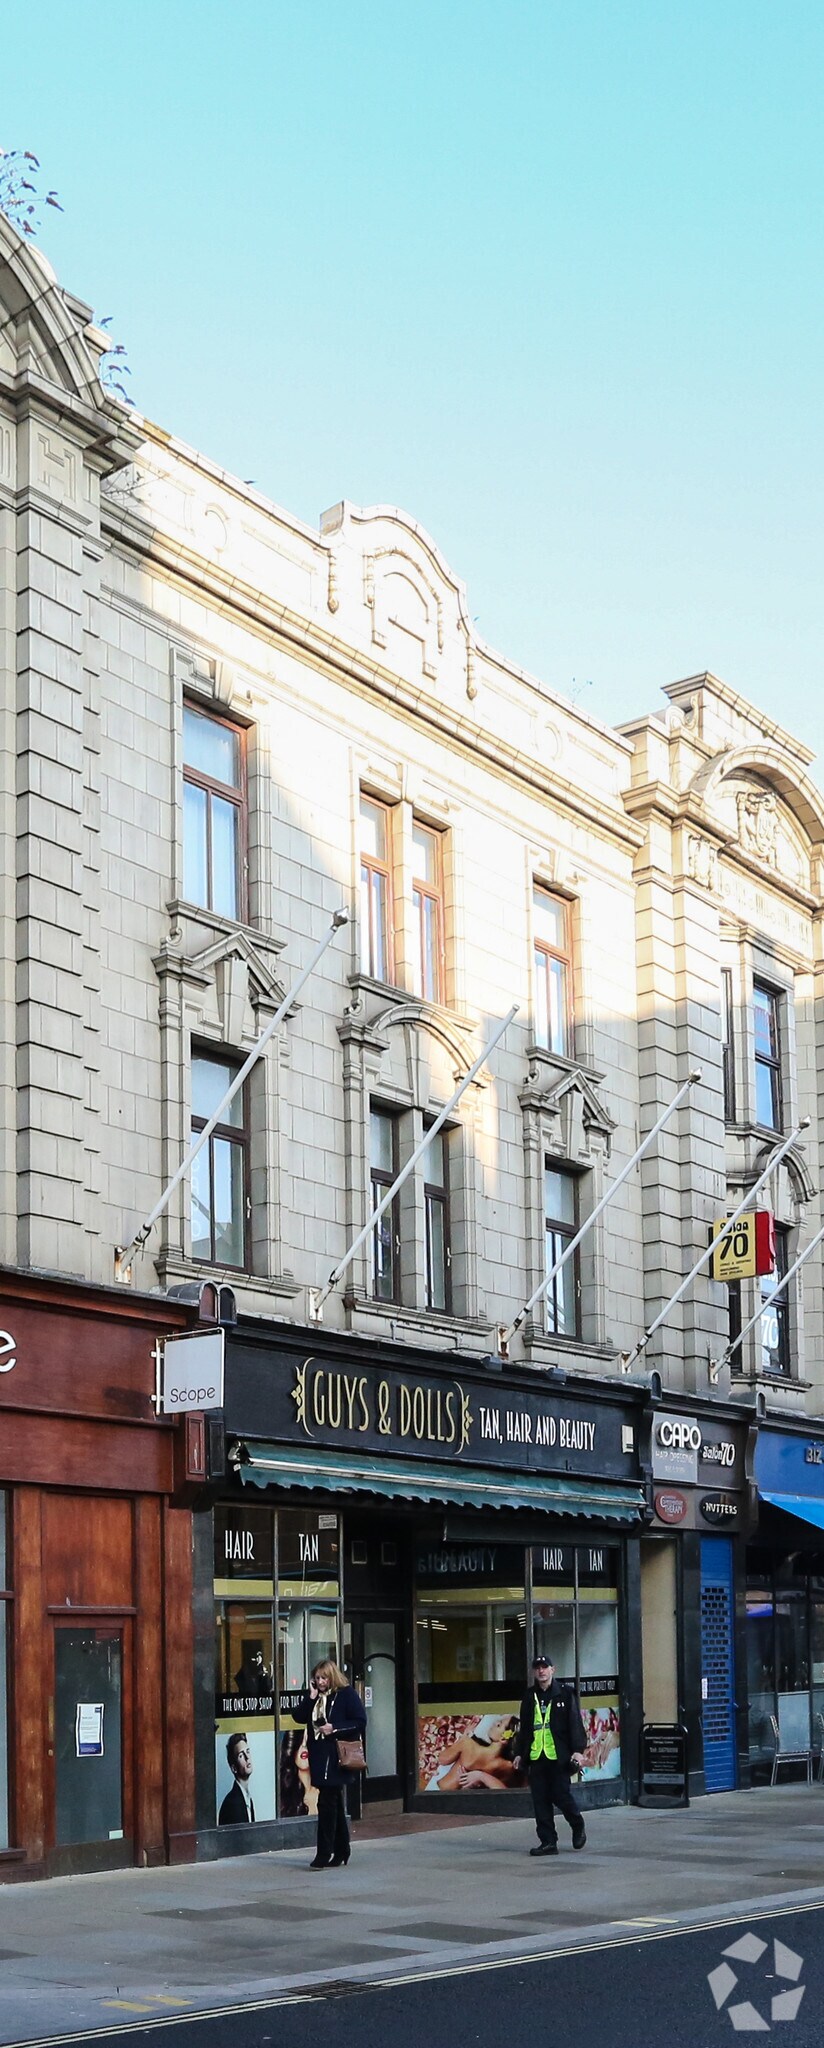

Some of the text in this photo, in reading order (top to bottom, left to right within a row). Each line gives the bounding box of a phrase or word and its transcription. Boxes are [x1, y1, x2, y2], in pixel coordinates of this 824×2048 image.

[720, 1232, 748, 1260] 70
[170, 1386, 215, 1403] Scope
[313, 1370, 456, 1443] GUYS & DOLLS
[479, 1407, 596, 1451] TAN, HAIR AND BEAUTY
[660, 1421, 702, 1450] CAPO
[225, 1530, 319, 1562] HAIR TAN
[543, 1548, 564, 1572] HAIR
[589, 1549, 603, 1571] TAN
[222, 1698, 232, 1711] THE
[233, 1698, 244, 1711] ONE
[245, 1697, 258, 1711] STOP
[259, 1696, 273, 1710] SHOP
